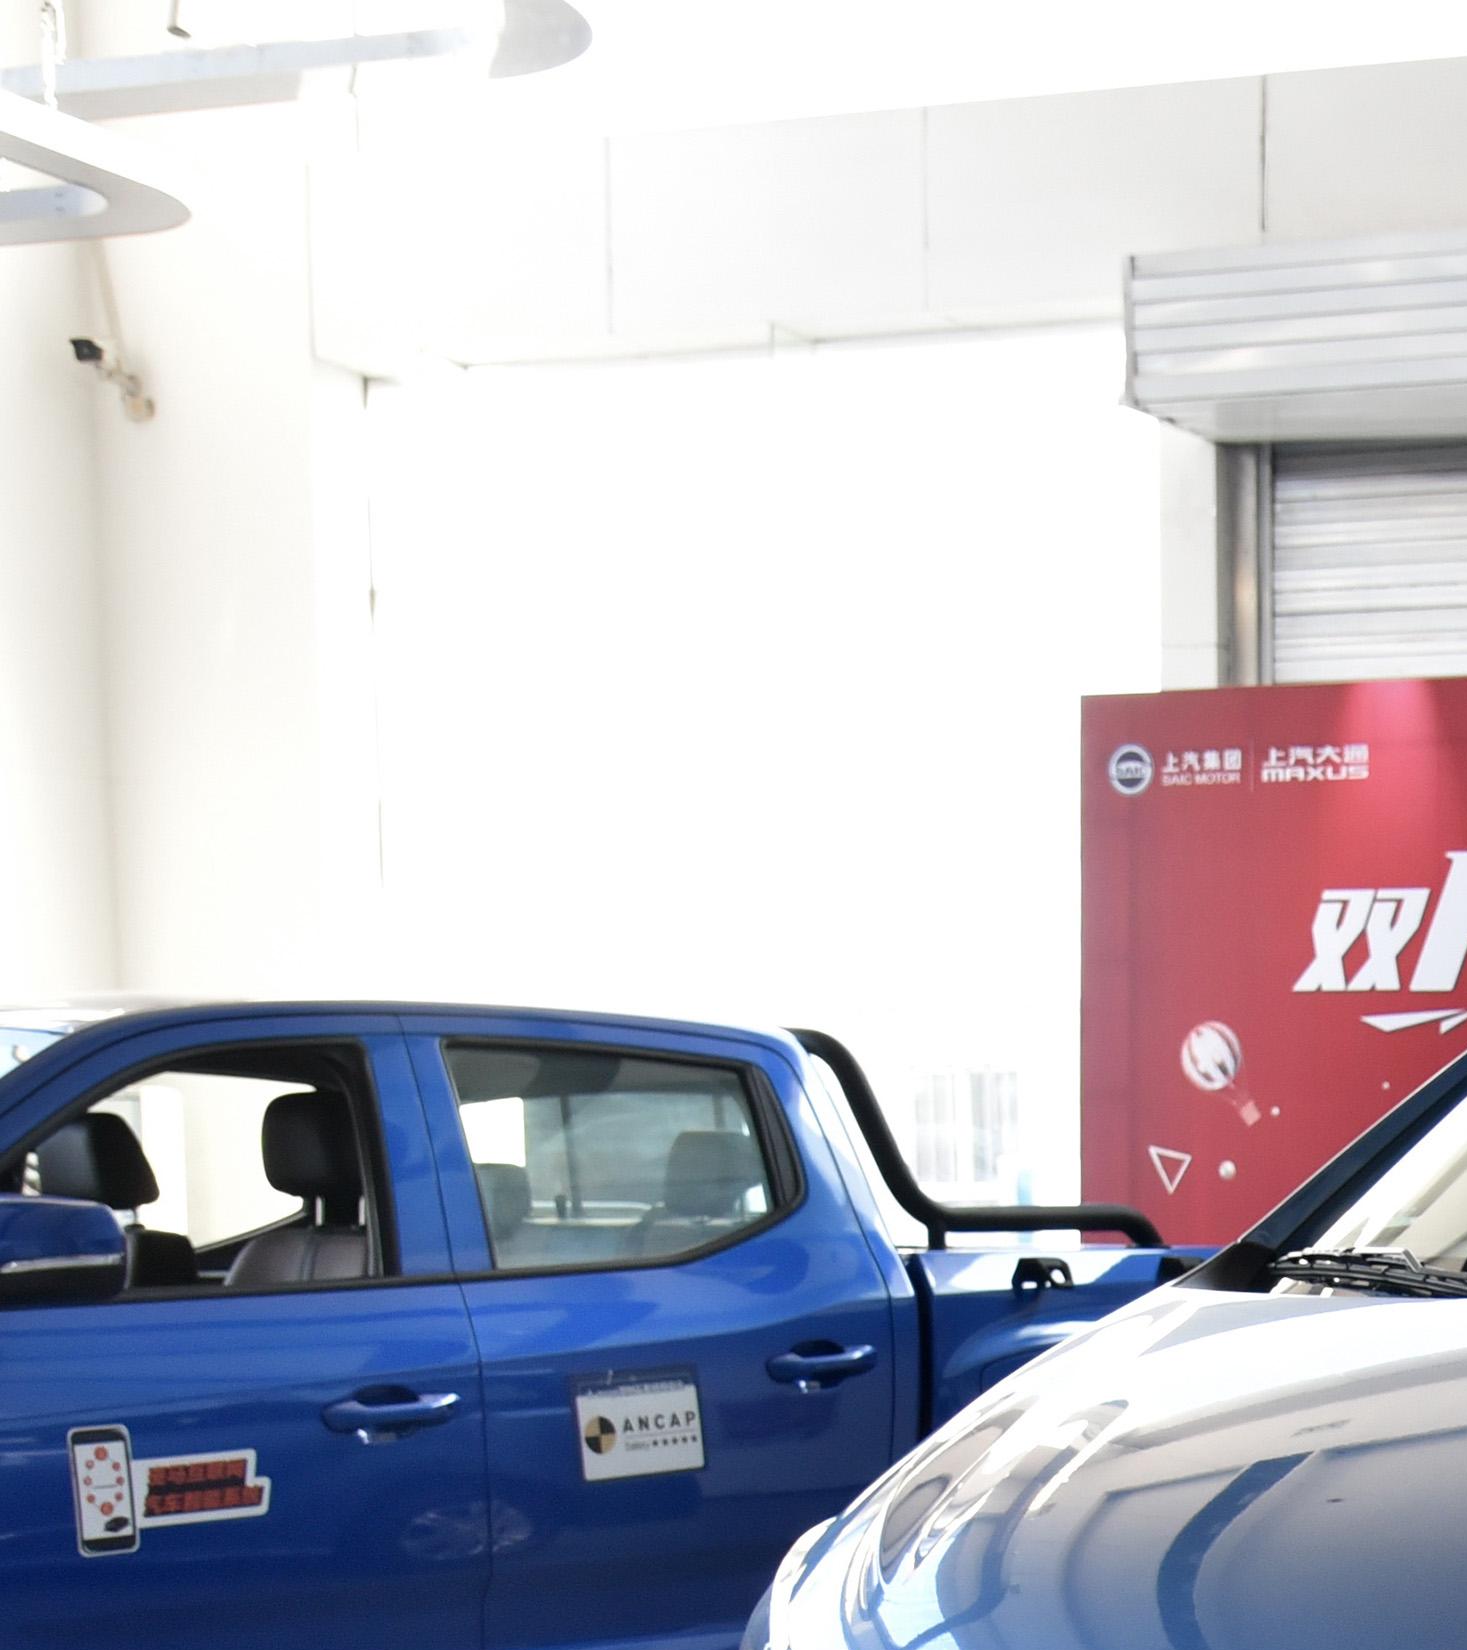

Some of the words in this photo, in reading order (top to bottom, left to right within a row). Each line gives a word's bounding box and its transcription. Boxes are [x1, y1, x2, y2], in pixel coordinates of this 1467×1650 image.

[1162, 749, 1242, 774] 上汽集团
[1263, 743, 1369, 767] 上汽大通
[1162, 772, 1192, 787] SAIC
[1195, 770, 1241, 785] MOTOR
[1261, 765, 1369, 783] MAXUS
[623, 1411, 696, 1433] ANCAP
